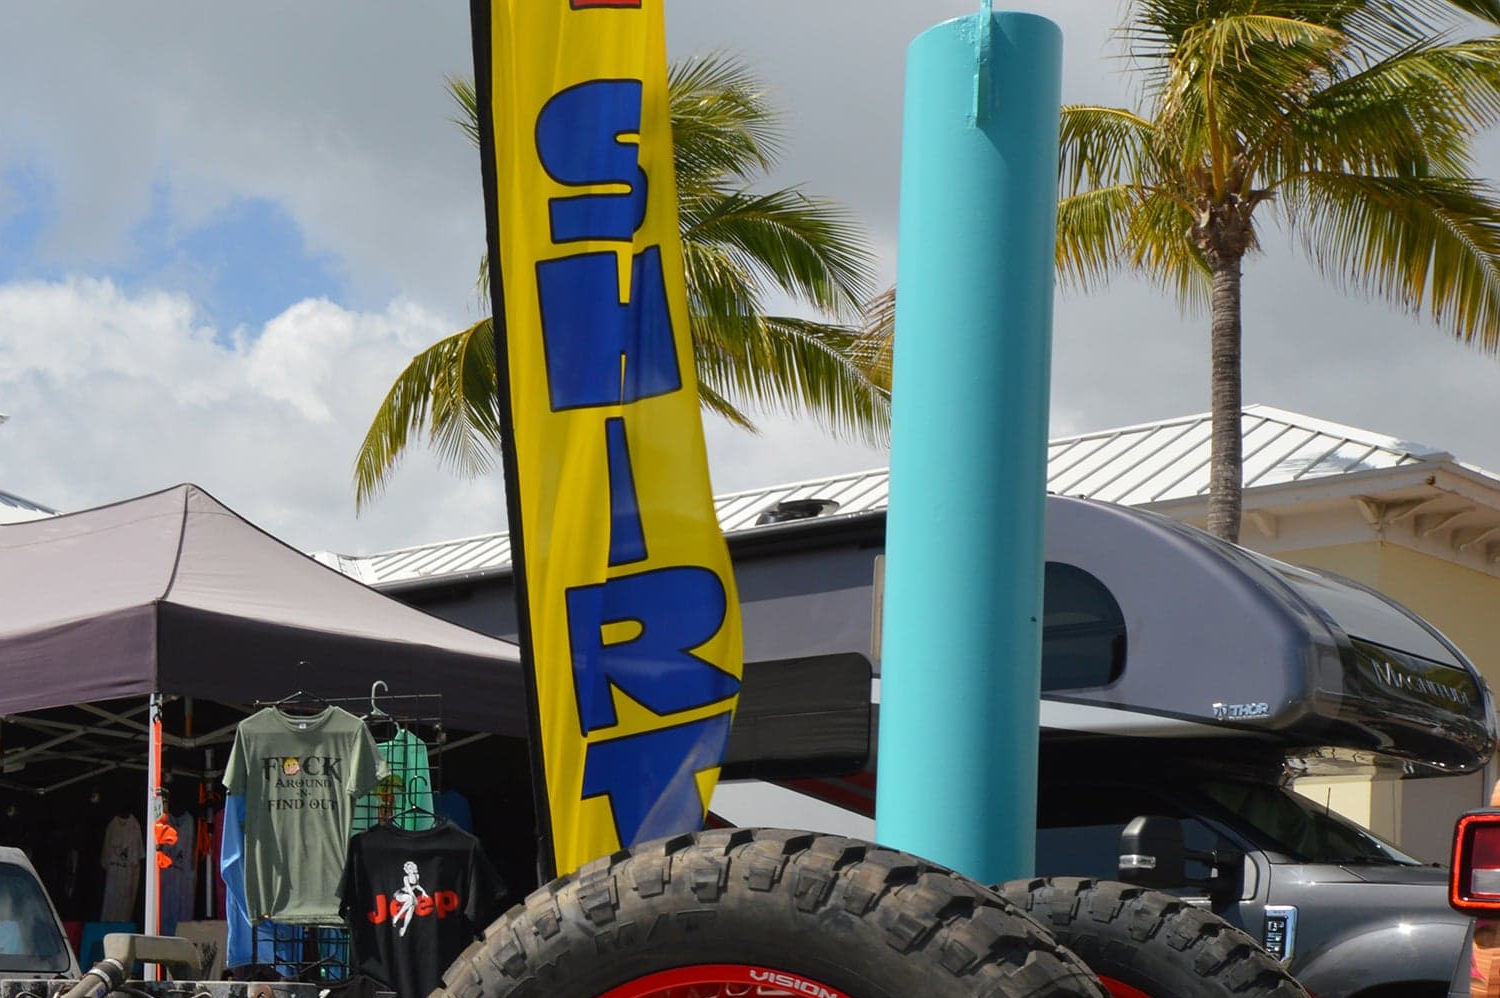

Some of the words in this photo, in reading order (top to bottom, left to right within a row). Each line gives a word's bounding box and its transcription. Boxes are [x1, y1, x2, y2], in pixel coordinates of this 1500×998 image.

[1229, 702, 1269, 716] THOR
[262, 755, 342, 783] FCK
[275, 778, 332, 789] AROUND
[267, 799, 305, 812] FIND
[309, 799, 338, 811] OUT
